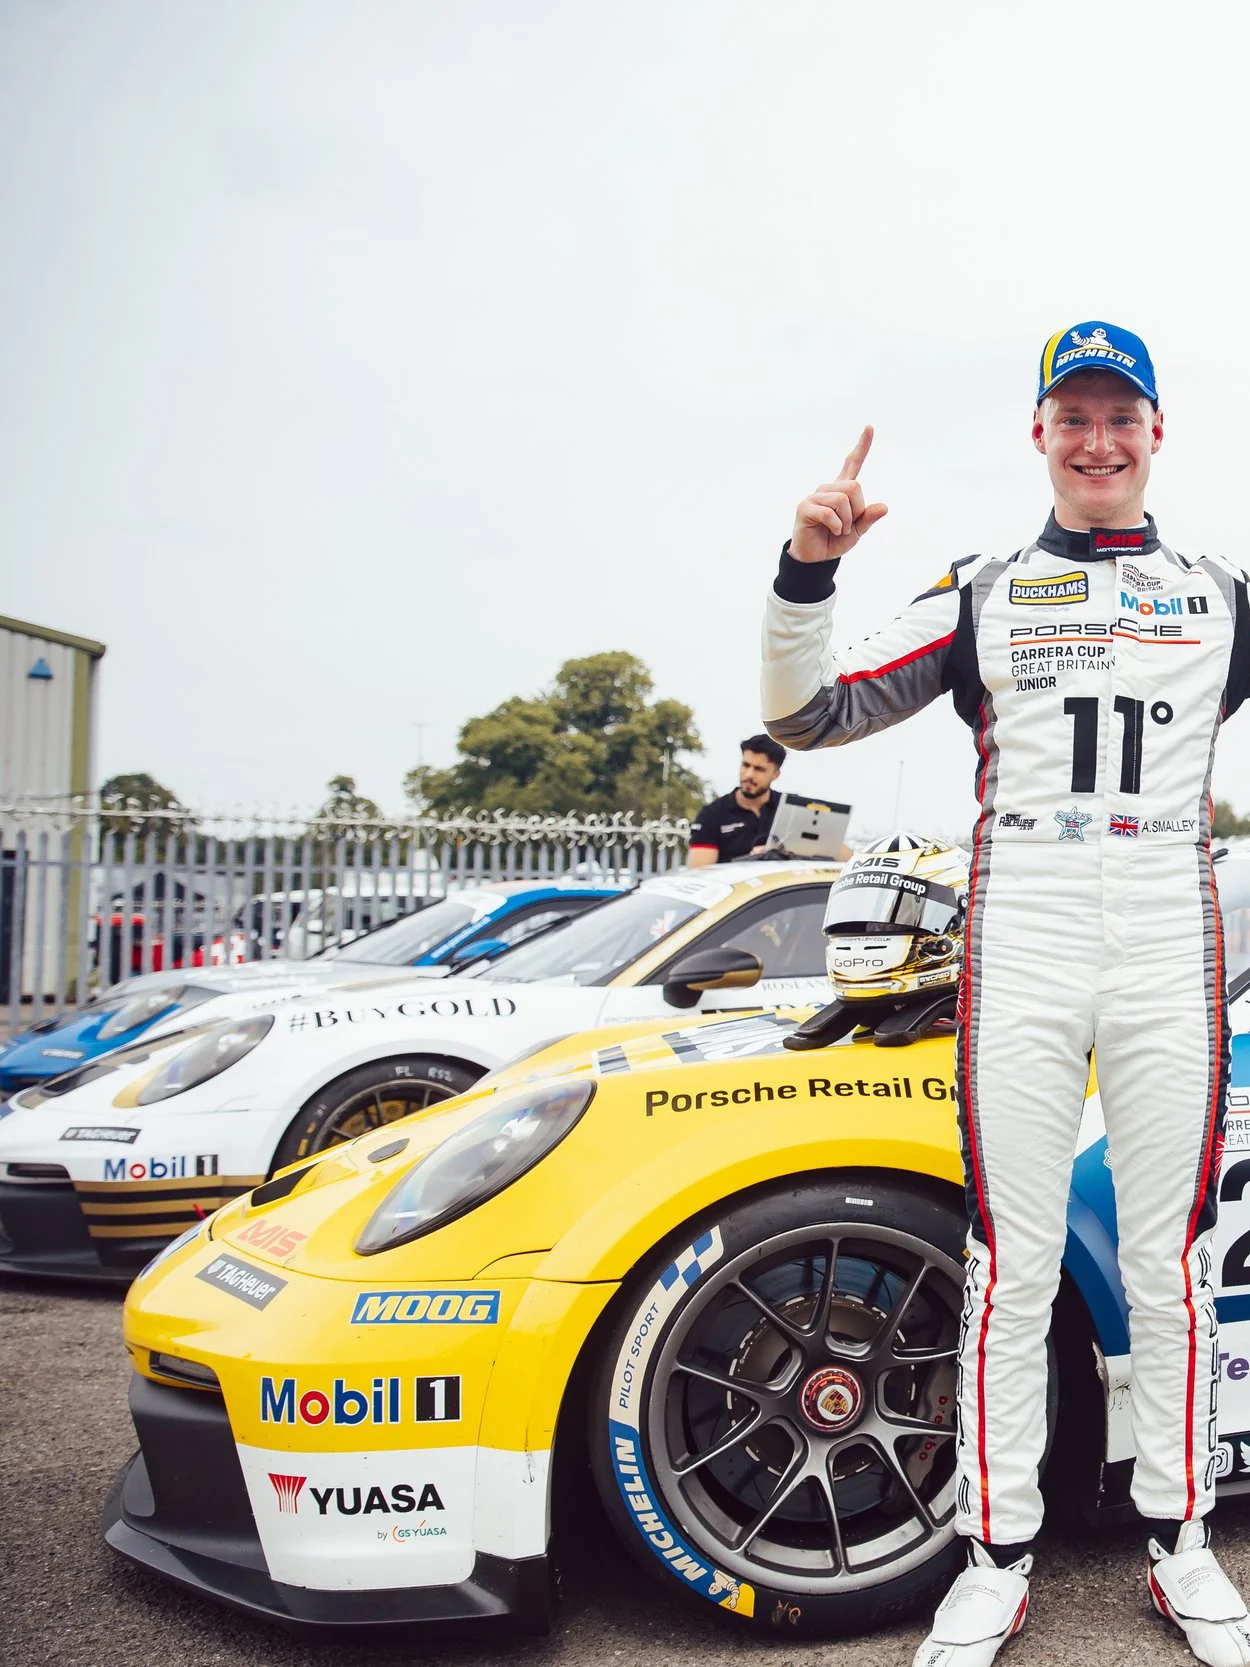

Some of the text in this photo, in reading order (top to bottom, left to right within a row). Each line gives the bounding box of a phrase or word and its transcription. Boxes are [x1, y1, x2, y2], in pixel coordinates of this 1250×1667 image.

[1056, 348, 1136, 368] MICHELIN
[1011, 580, 1087, 599] DUCKHAMS
[1120, 591, 1183, 615] Mobil
[1010, 617, 1182, 638] PORSCHE
[1011, 645, 1105, 662] CARRERA CUP
[1011, 656, 1115, 677] GREAT BRITAIN
[1015, 677, 1057, 691] JUNIOR
[1141, 820, 1198, 833] A.SMALLEY
[852, 857, 901, 870] MIS
[855, 873, 888, 885] Retail
[889, 874, 926, 895] Group
[835, 958, 884, 967] GoPro
[645, 1081, 797, 1117] Porsche
[808, 1077, 912, 1099] Retail
[105, 1155, 185, 1180] Mobil
[356, 1294, 495, 1321] MOOG
[618, 1302, 659, 1410] PILOT SPORT
[260, 1376, 400, 1426] Mobil
[309, 1483, 445, 1516] YUASA
[613, 1436, 708, 1582] MICHELIN
[377, 1526, 447, 1541] by GS YUASA
